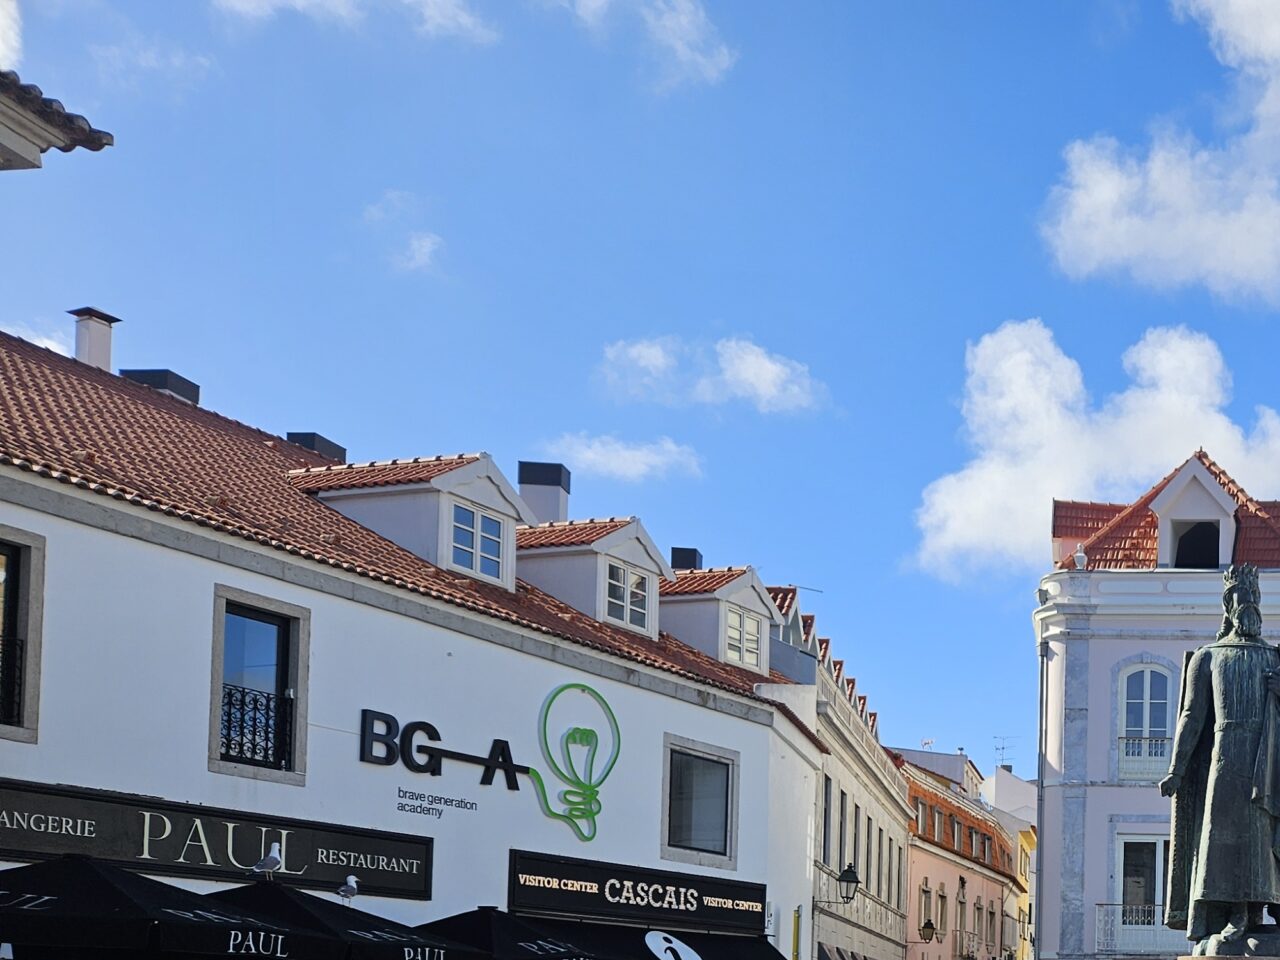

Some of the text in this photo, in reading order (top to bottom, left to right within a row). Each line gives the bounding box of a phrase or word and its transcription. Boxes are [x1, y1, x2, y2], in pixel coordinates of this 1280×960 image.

[396, 802, 443, 820] academy
[397, 786, 477, 811] brave generation
[136, 810, 308, 875] PAUL
[316, 848, 421, 875] RESTAURANT
[518, 874, 762, 912] VISITOR CENTER CASCAIS VISITOR CENTER
[227, 930, 289, 958] PAUL
